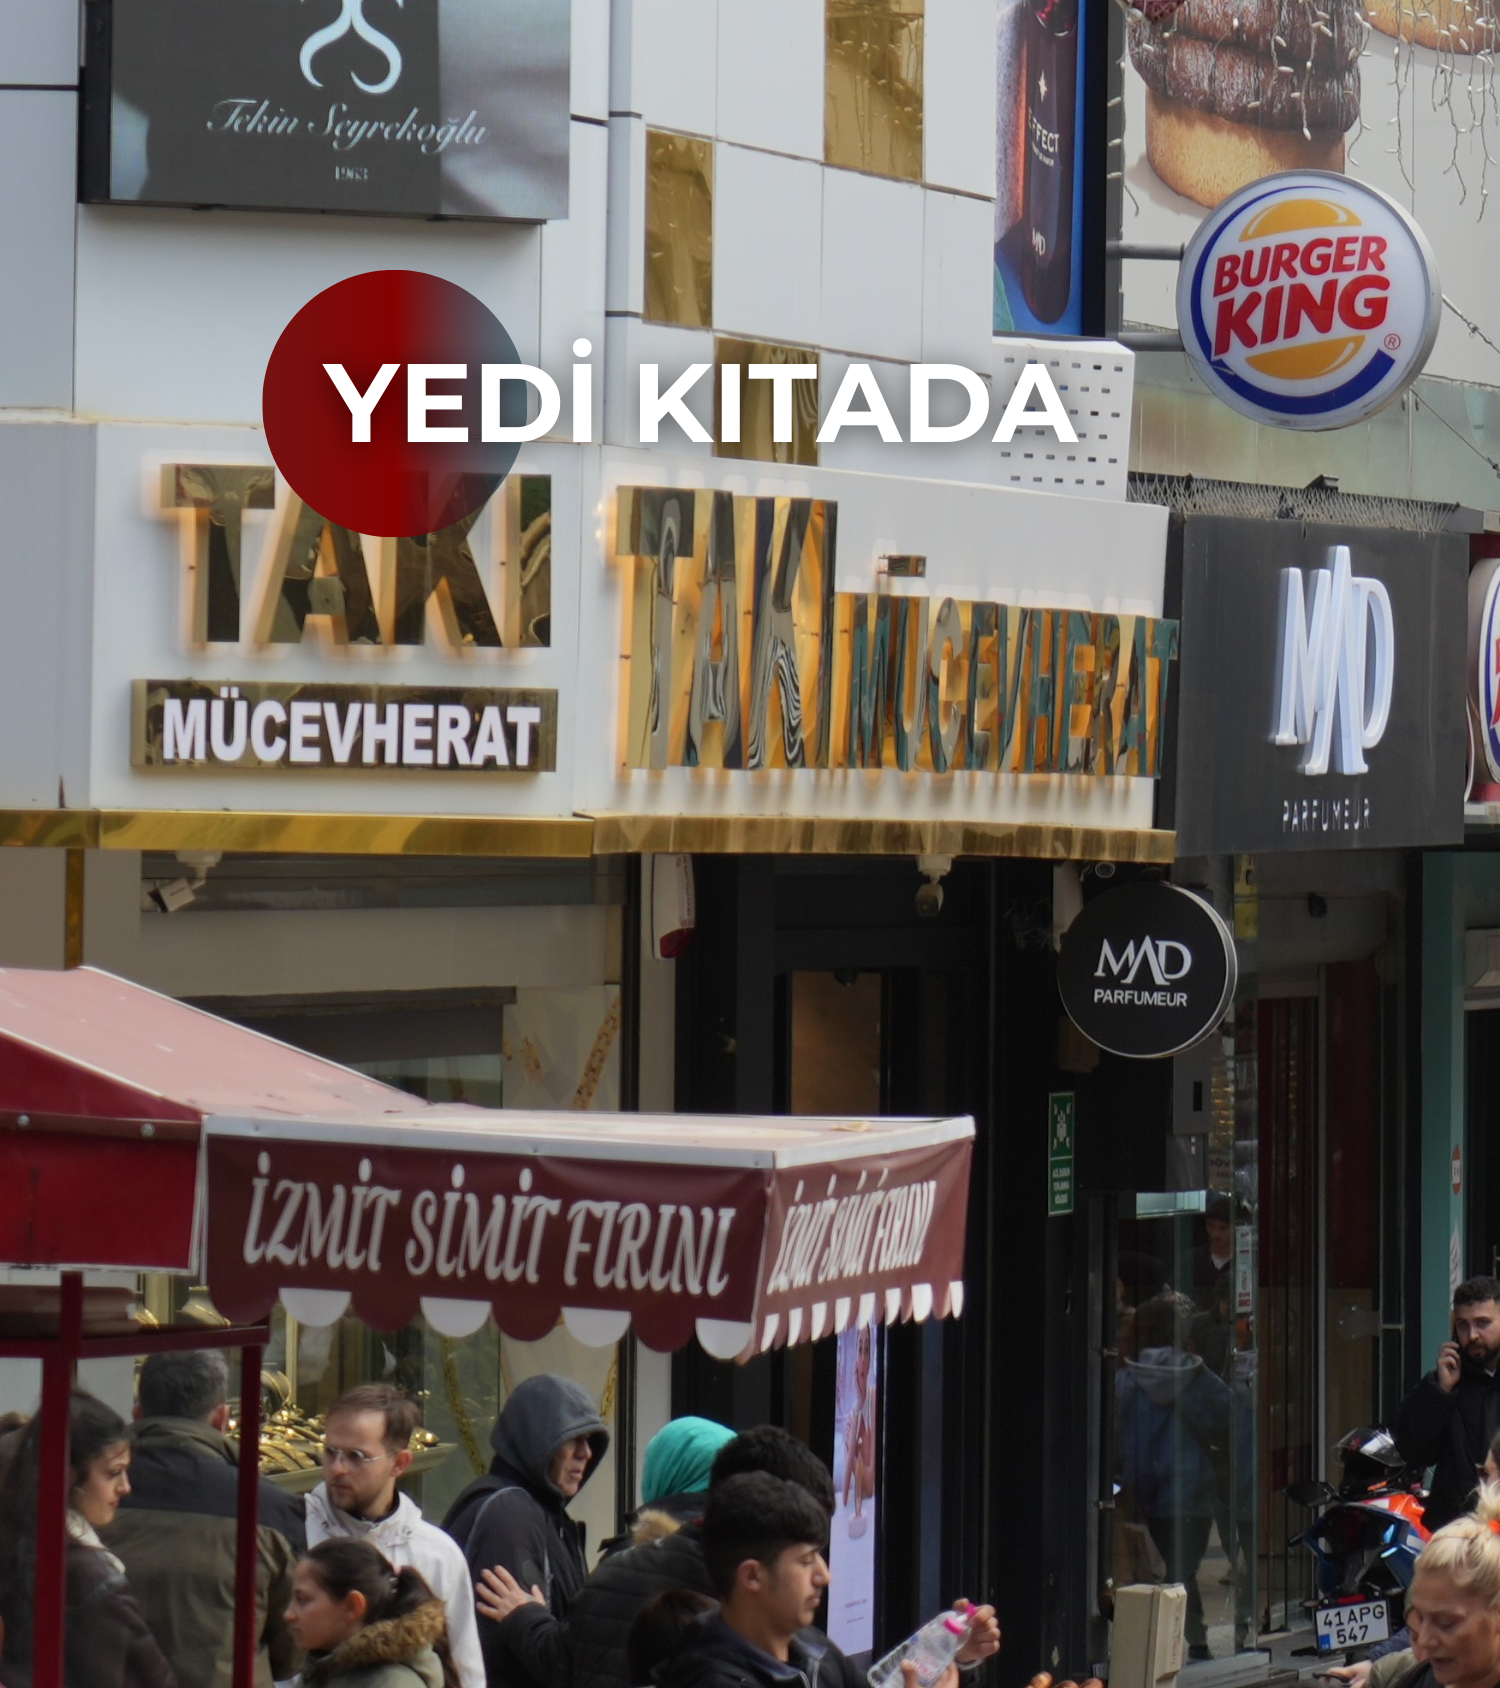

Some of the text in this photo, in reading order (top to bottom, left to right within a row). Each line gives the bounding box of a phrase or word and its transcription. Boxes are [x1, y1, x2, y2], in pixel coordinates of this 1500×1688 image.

[209, 99, 488, 154] Tekin Seyrekoğlu
[1212, 235, 1389, 298] BURGER
[1213, 274, 1391, 357] KING
[614, 485, 838, 771] TAKI
[162, 687, 541, 768] MÜCEVHERAT
[1282, 798, 1371, 832] PARFUMEUR
[1093, 934, 1193, 986] MAD
[1093, 989, 1188, 1008] PARFUMEUR
[242, 1150, 737, 1298] İZMİT SİMİT FIRINI
[766, 1167, 937, 1296] İZMİT SİMİT FIRINI
[1336, 1624, 1370, 1645] 547
